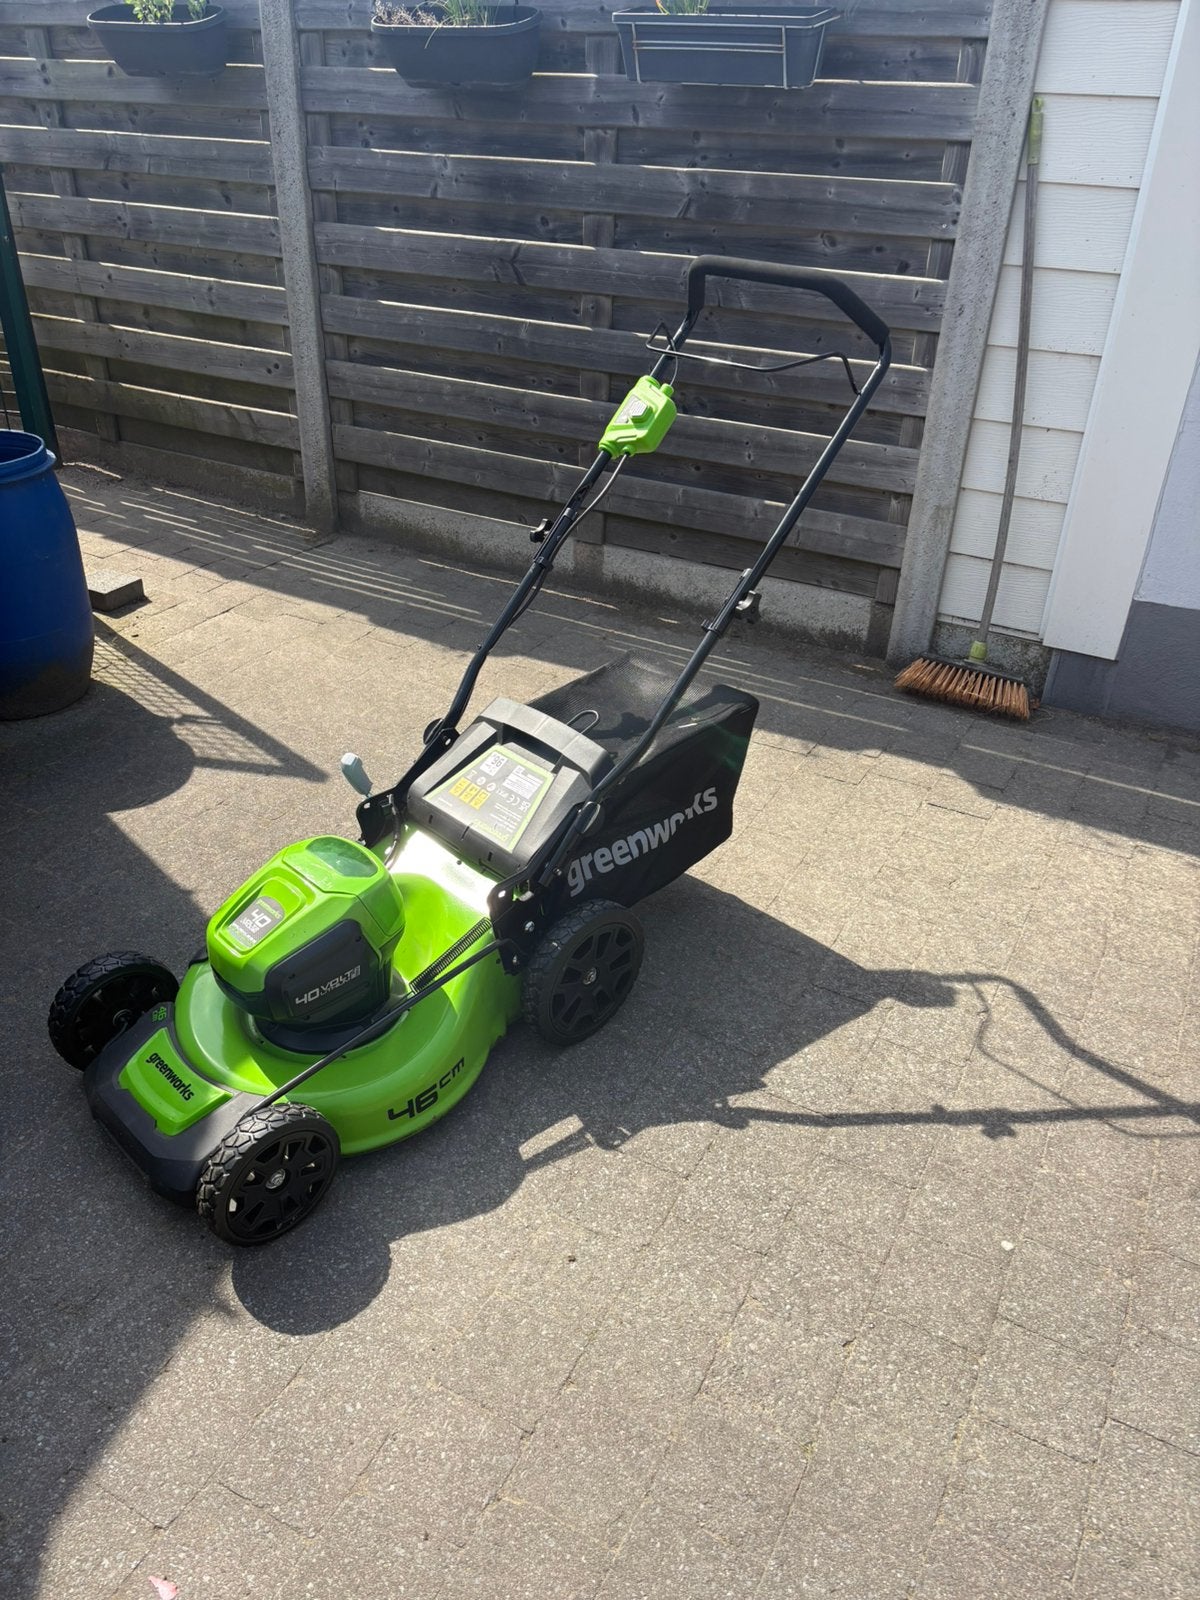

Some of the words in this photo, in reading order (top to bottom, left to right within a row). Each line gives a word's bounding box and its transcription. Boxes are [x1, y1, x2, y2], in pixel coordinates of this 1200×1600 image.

[251, 909, 271, 928] 40
[295, 988, 319, 1004] 40
[145, 1052, 194, 1101] greenworks
